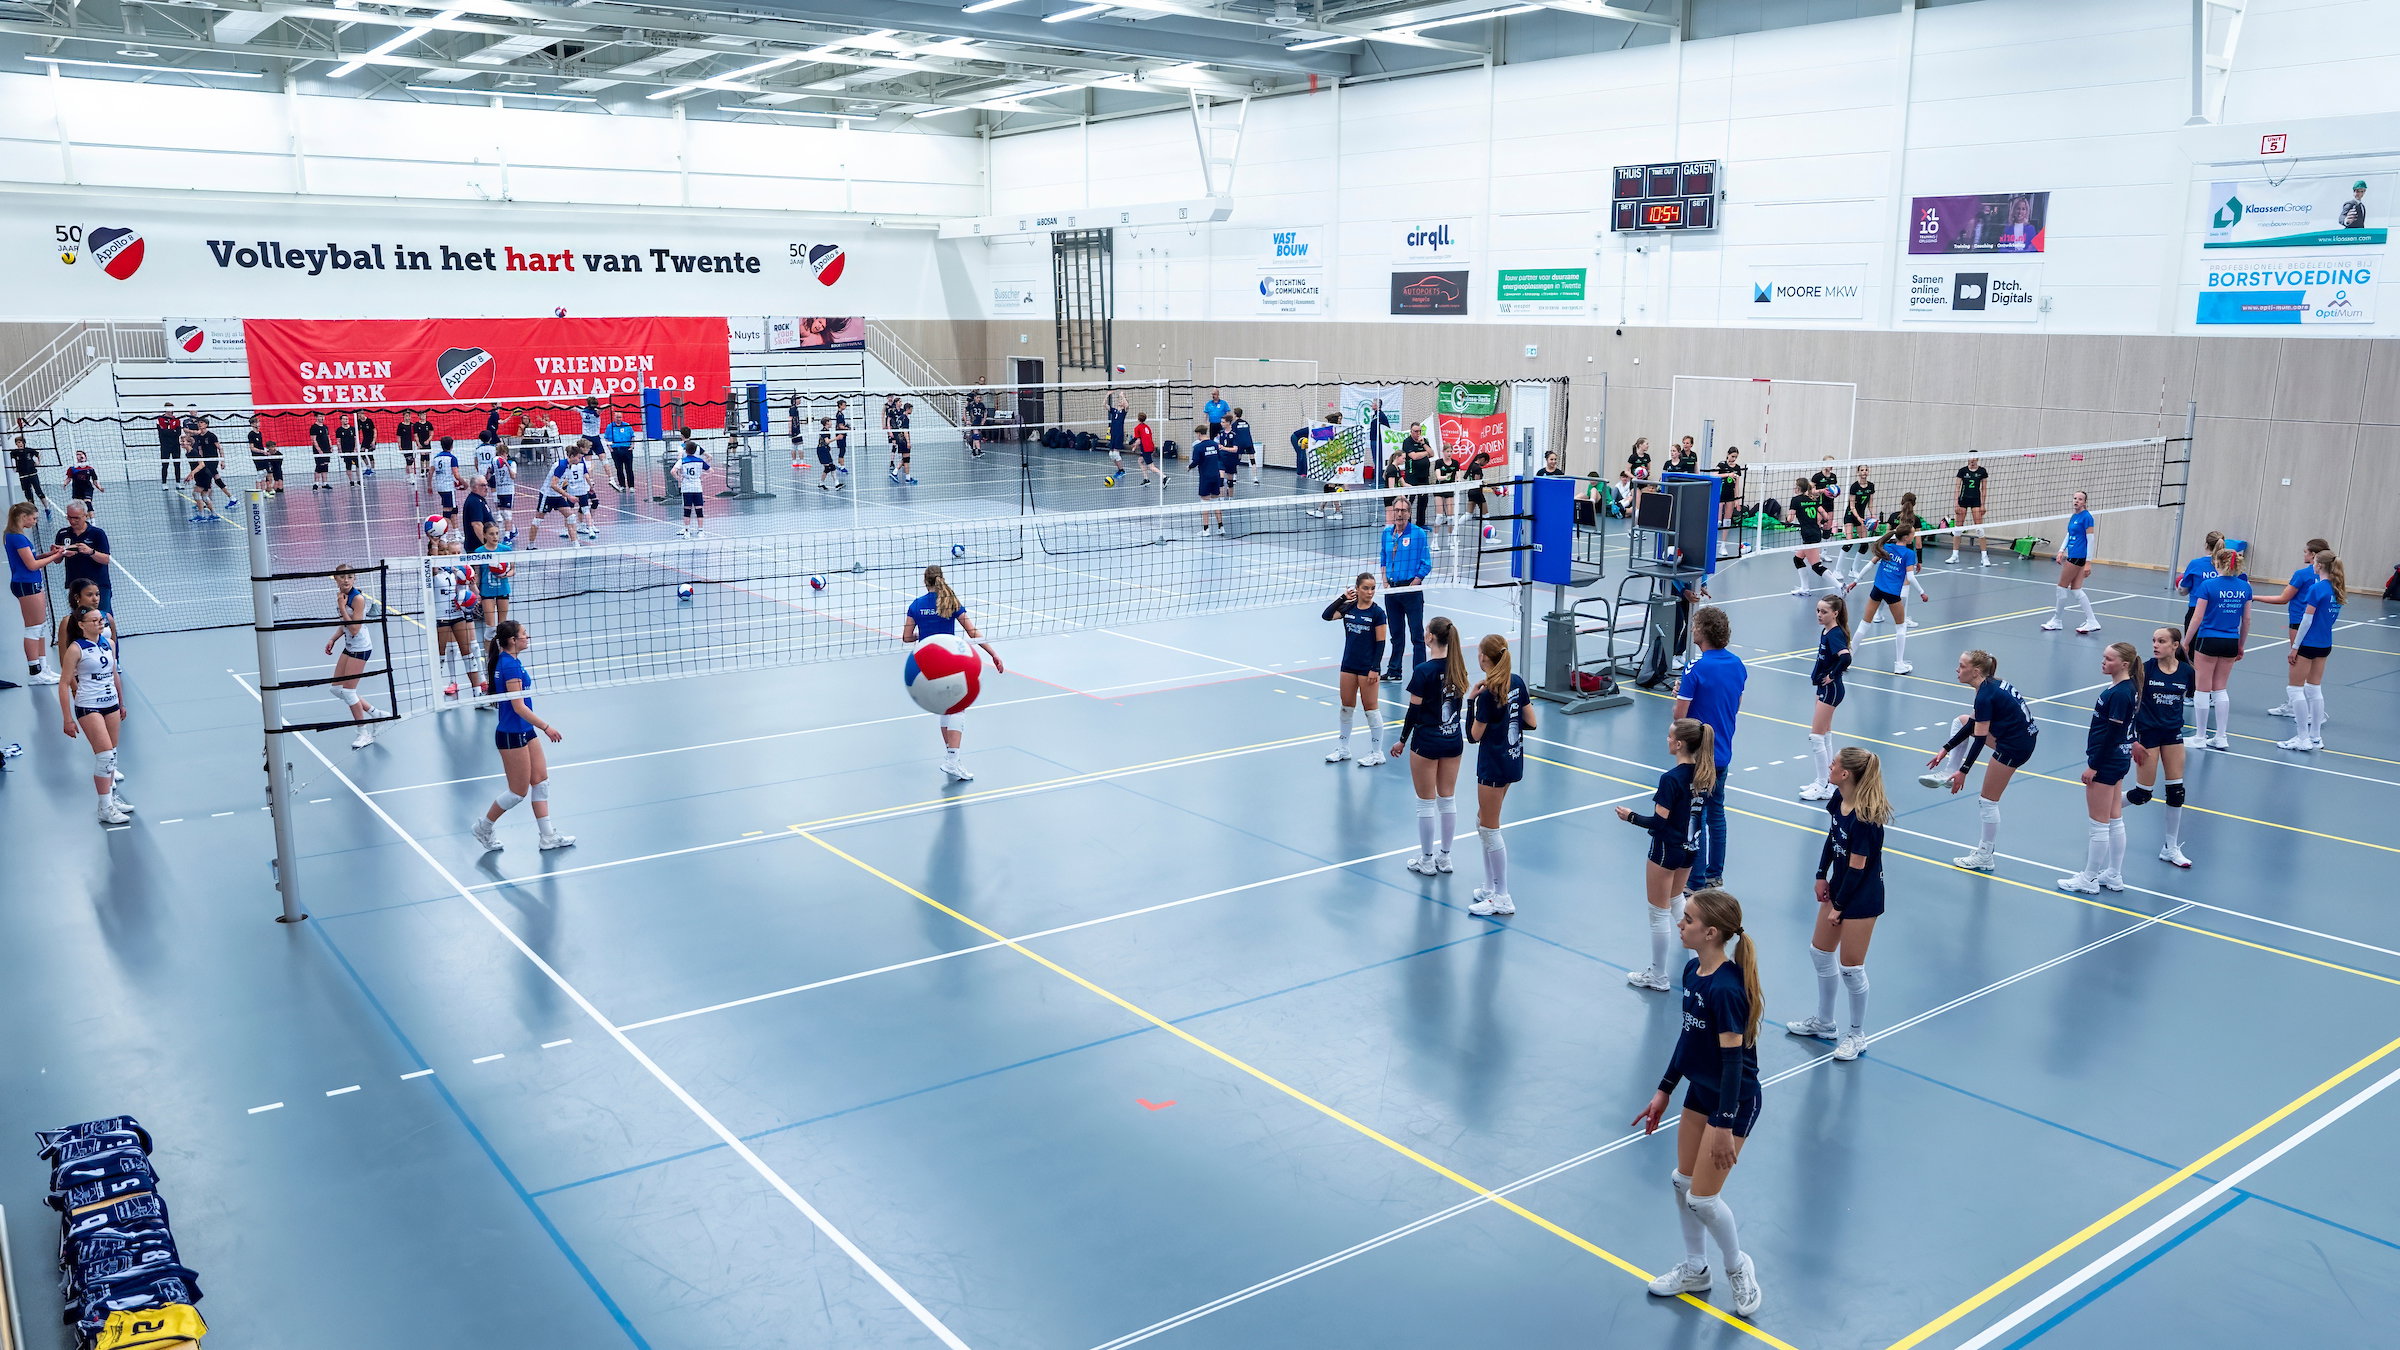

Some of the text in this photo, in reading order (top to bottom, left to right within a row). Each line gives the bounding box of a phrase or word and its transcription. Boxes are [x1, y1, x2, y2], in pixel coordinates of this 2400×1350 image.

[2270, 142, 2278, 150] 5
[1618, 168, 1642, 179] THUIS
[1684, 164, 1713, 175] GASTEN
[1649, 206, 1679, 222] 10:54
[1921, 208, 1939, 220] XL
[2245, 202, 2312, 214] KlaassenGroep
[56, 225, 82, 242] 50
[1920, 221, 1939, 234] 10
[1273, 232, 1296, 244] VAST
[1407, 224, 1455, 251] cirqll.
[2000, 234, 2026, 242] xl10.nl
[96, 238, 128, 263] Apollo
[790, 244, 806, 257] 50
[1276, 244, 1308, 256] BOUW
[206, 240, 761, 276] Volleybal in het hart van Twente
[814, 253, 834, 273] Apollo
[2210, 263, 2282, 271] PROFESSIONELE
[1912, 275, 1943, 284] Samen
[2208, 269, 2371, 287] BORSTVOEDING
[1777, 286, 1858, 297] MOORE MKW
[1911, 285, 1939, 293] online
[1993, 280, 2022, 291] Dtch.
[1910, 296, 1948, 306] groeien.
[1992, 292, 2033, 306] Digitals
[2315, 309, 2363, 319] OptiMum
[774, 323, 789, 331] ROCK
[734, 331, 760, 341] Nuyts
[300, 361, 392, 380] SAMEN
[534, 356, 654, 374] VRIENDEN
[445, 359, 478, 388] Apollo
[536, 379, 584, 396] VAN
[684, 376, 695, 391] 8
[302, 385, 386, 403] STERK
[1492, 422, 1504, 435] DIE
[480, 452, 490, 460] 10
[438, 460, 442, 469] 6
[573, 471, 579, 480] 5
[686, 468, 695, 476] 16
[1969, 480, 1975, 488] 2
[1861, 496, 1867, 504] 7
[1804, 507, 1817, 518] 10
[253, 510, 261, 535] BOSAN
[424, 559, 432, 584] BOSAN
[100, 656, 108, 668] 9
[111, 1178, 140, 1192] 5
[142, 1250, 171, 1263] 8
[131, 1319, 164, 1336] 2
